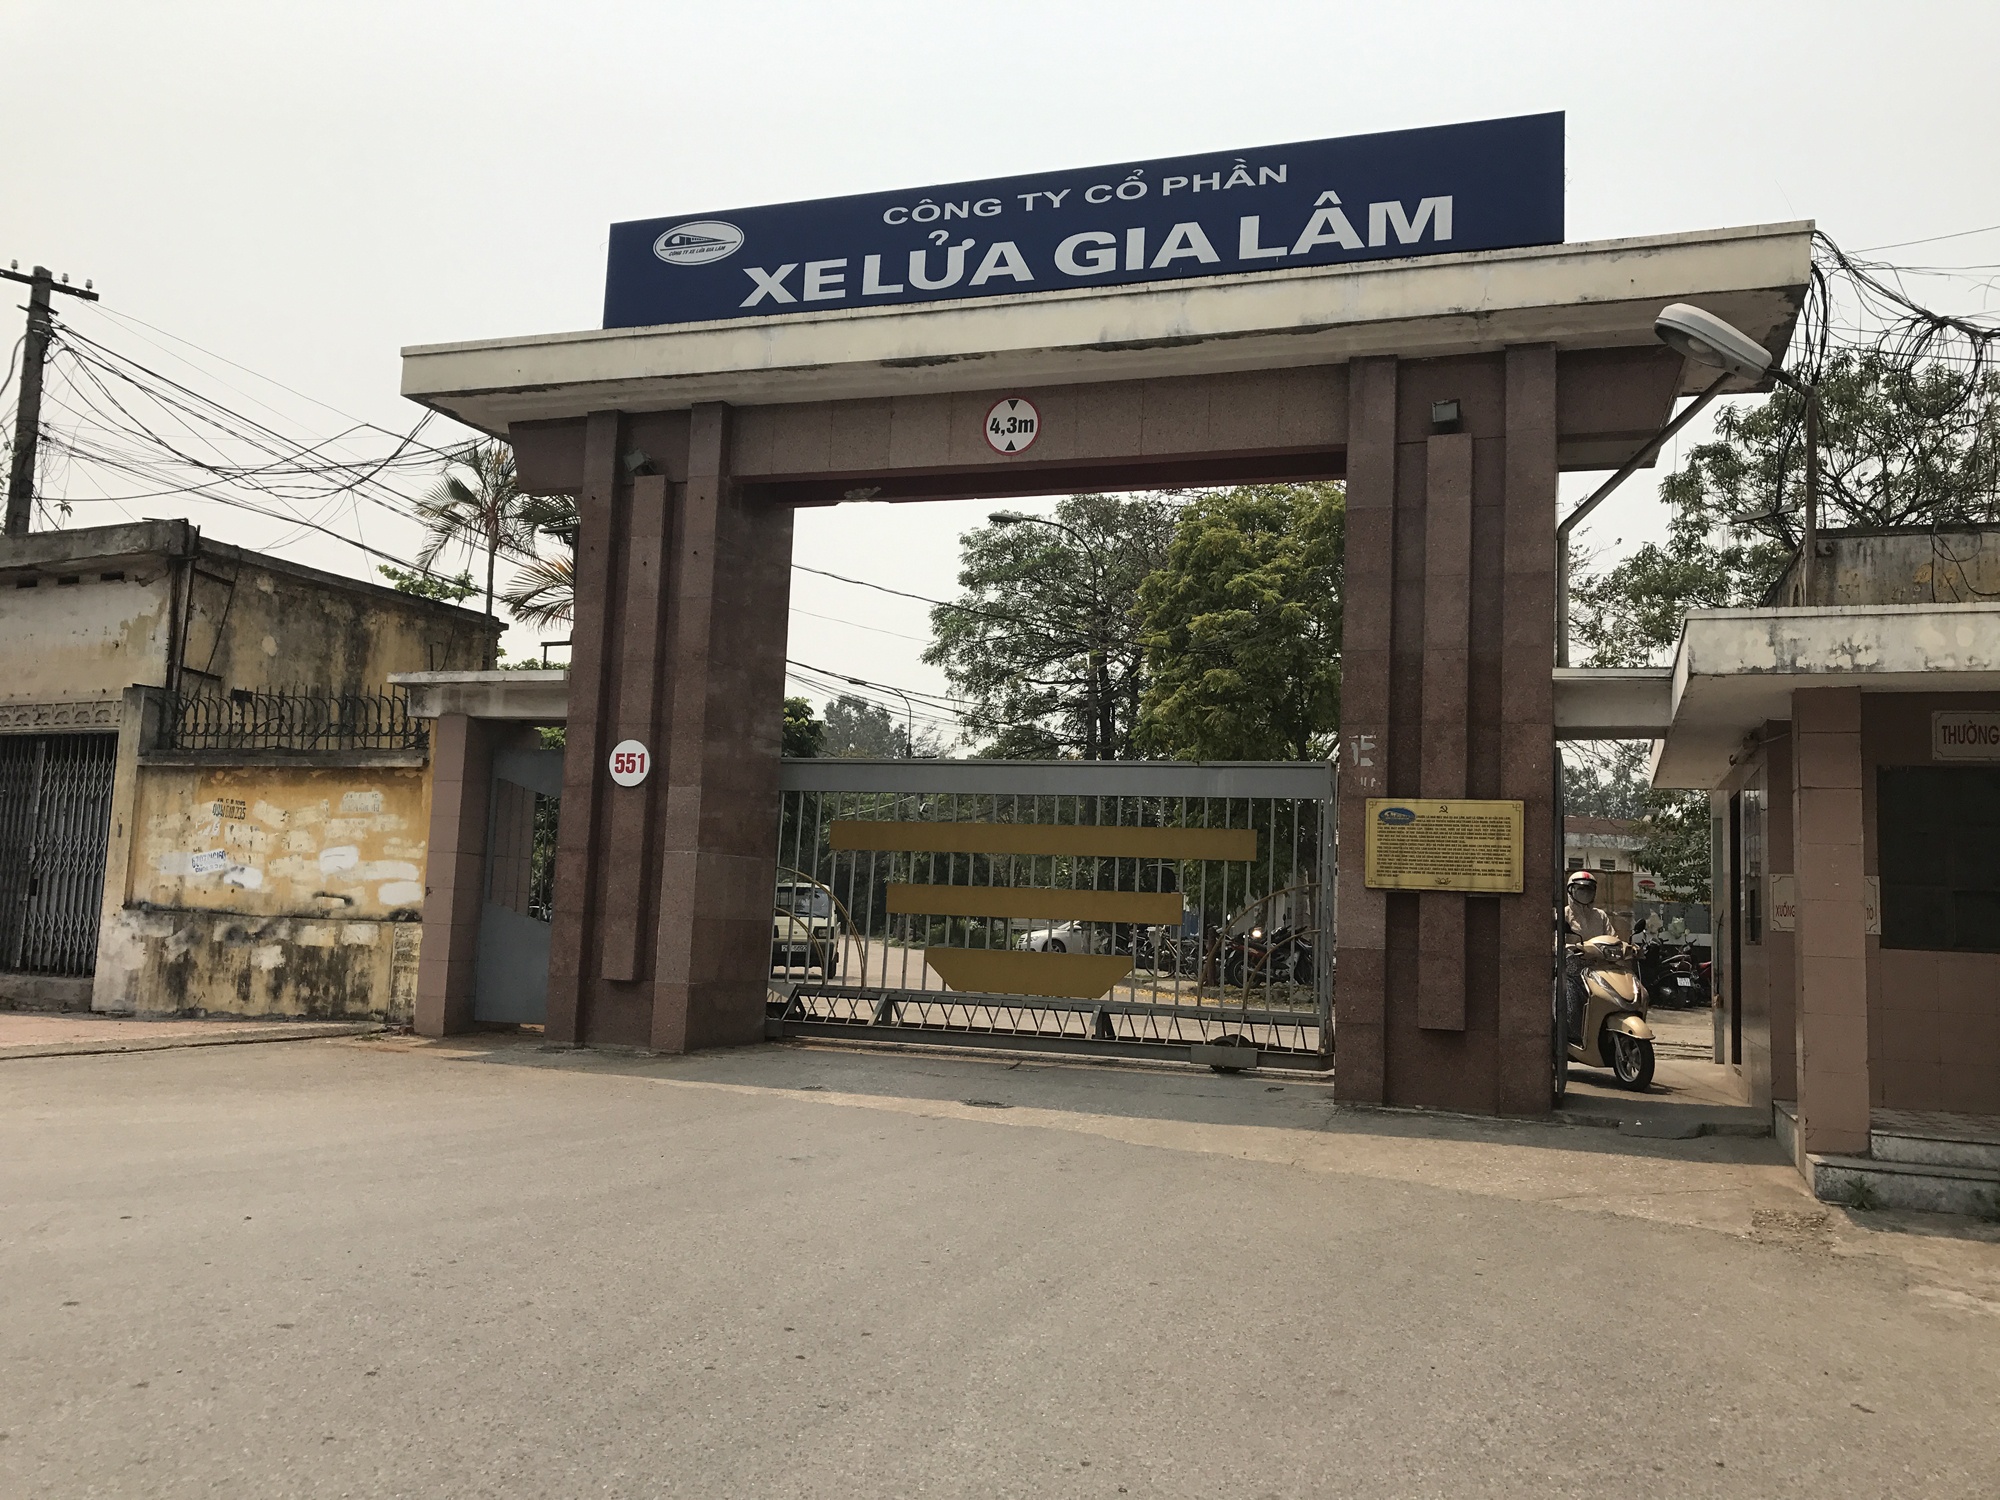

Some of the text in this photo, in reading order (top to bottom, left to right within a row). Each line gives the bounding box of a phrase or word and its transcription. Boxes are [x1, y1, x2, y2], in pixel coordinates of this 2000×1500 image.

[883, 158, 1288, 225] CÔNG TY CỔ PHẦN
[738, 190, 1453, 308] XE LỬA GIA LÂM
[990, 416, 1034, 437] 4,3m
[614, 752, 645, 774] 551
